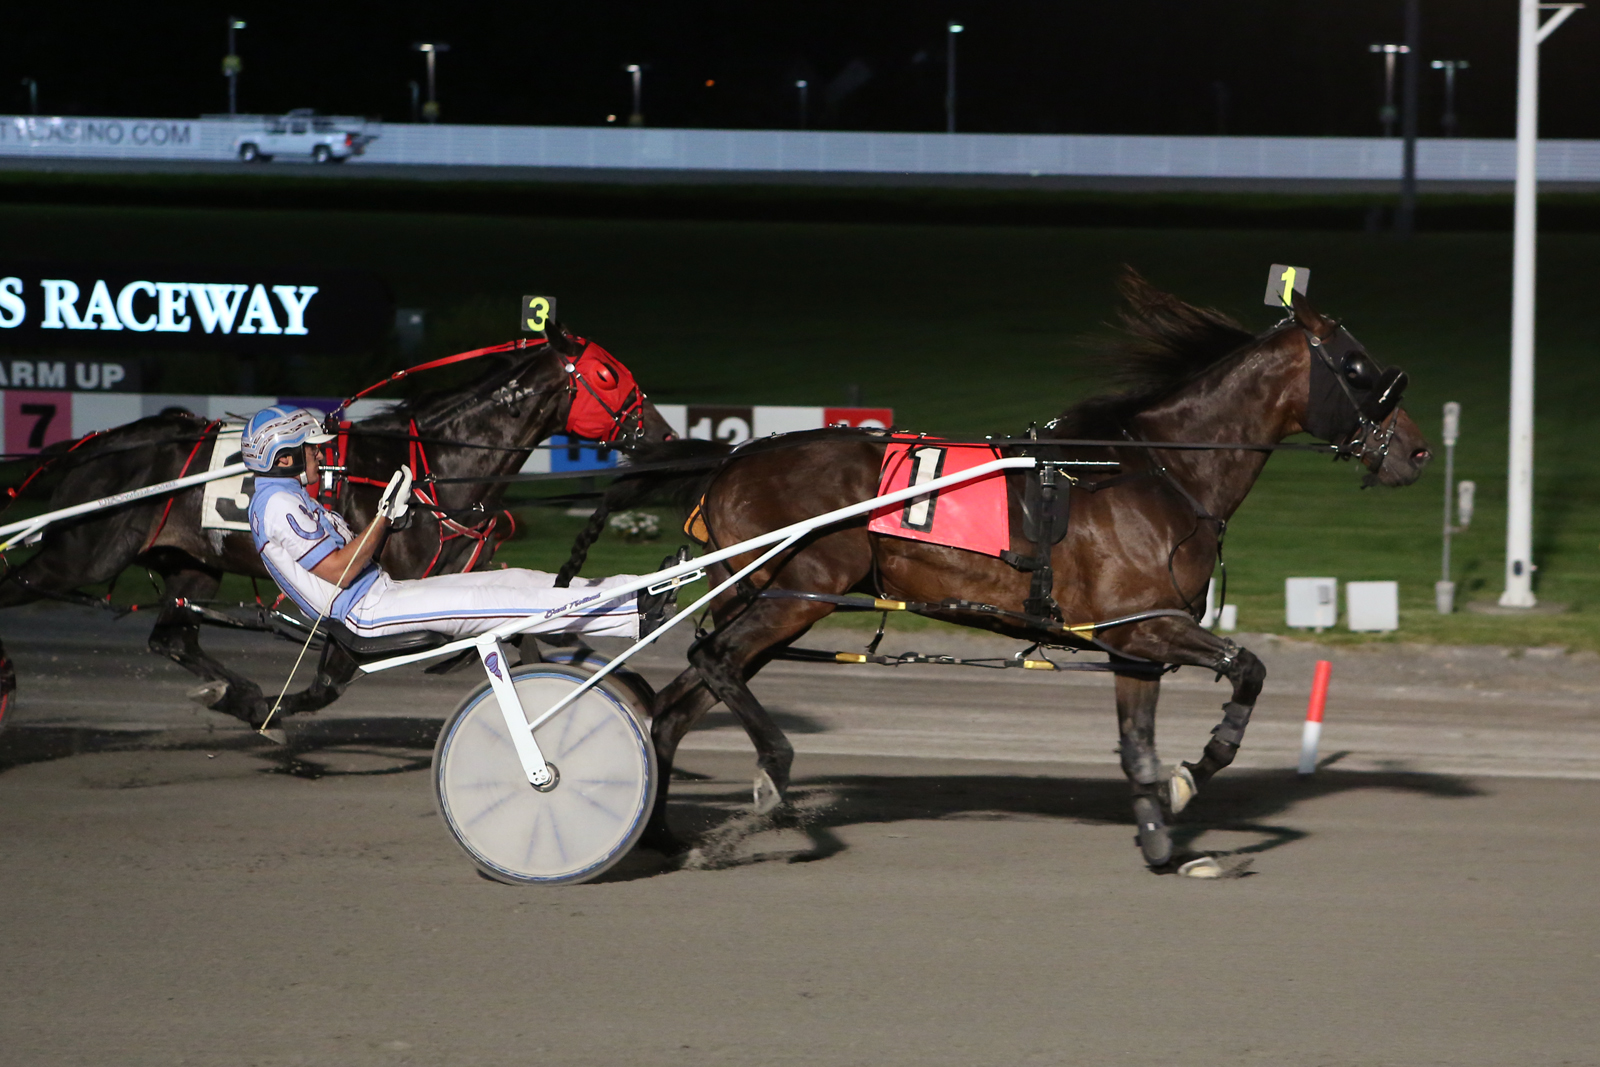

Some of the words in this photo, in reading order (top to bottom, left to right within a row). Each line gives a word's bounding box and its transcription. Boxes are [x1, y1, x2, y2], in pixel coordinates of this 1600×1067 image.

[0, 277, 26, 329] S
[40, 279, 319, 335] RACEWAY
[1281, 266, 1297, 307] 1
[526, 296, 550, 332] 3
[75, 363, 126, 390] UP
[20, 403, 57, 449] 7
[900, 445, 948, 533] 1
